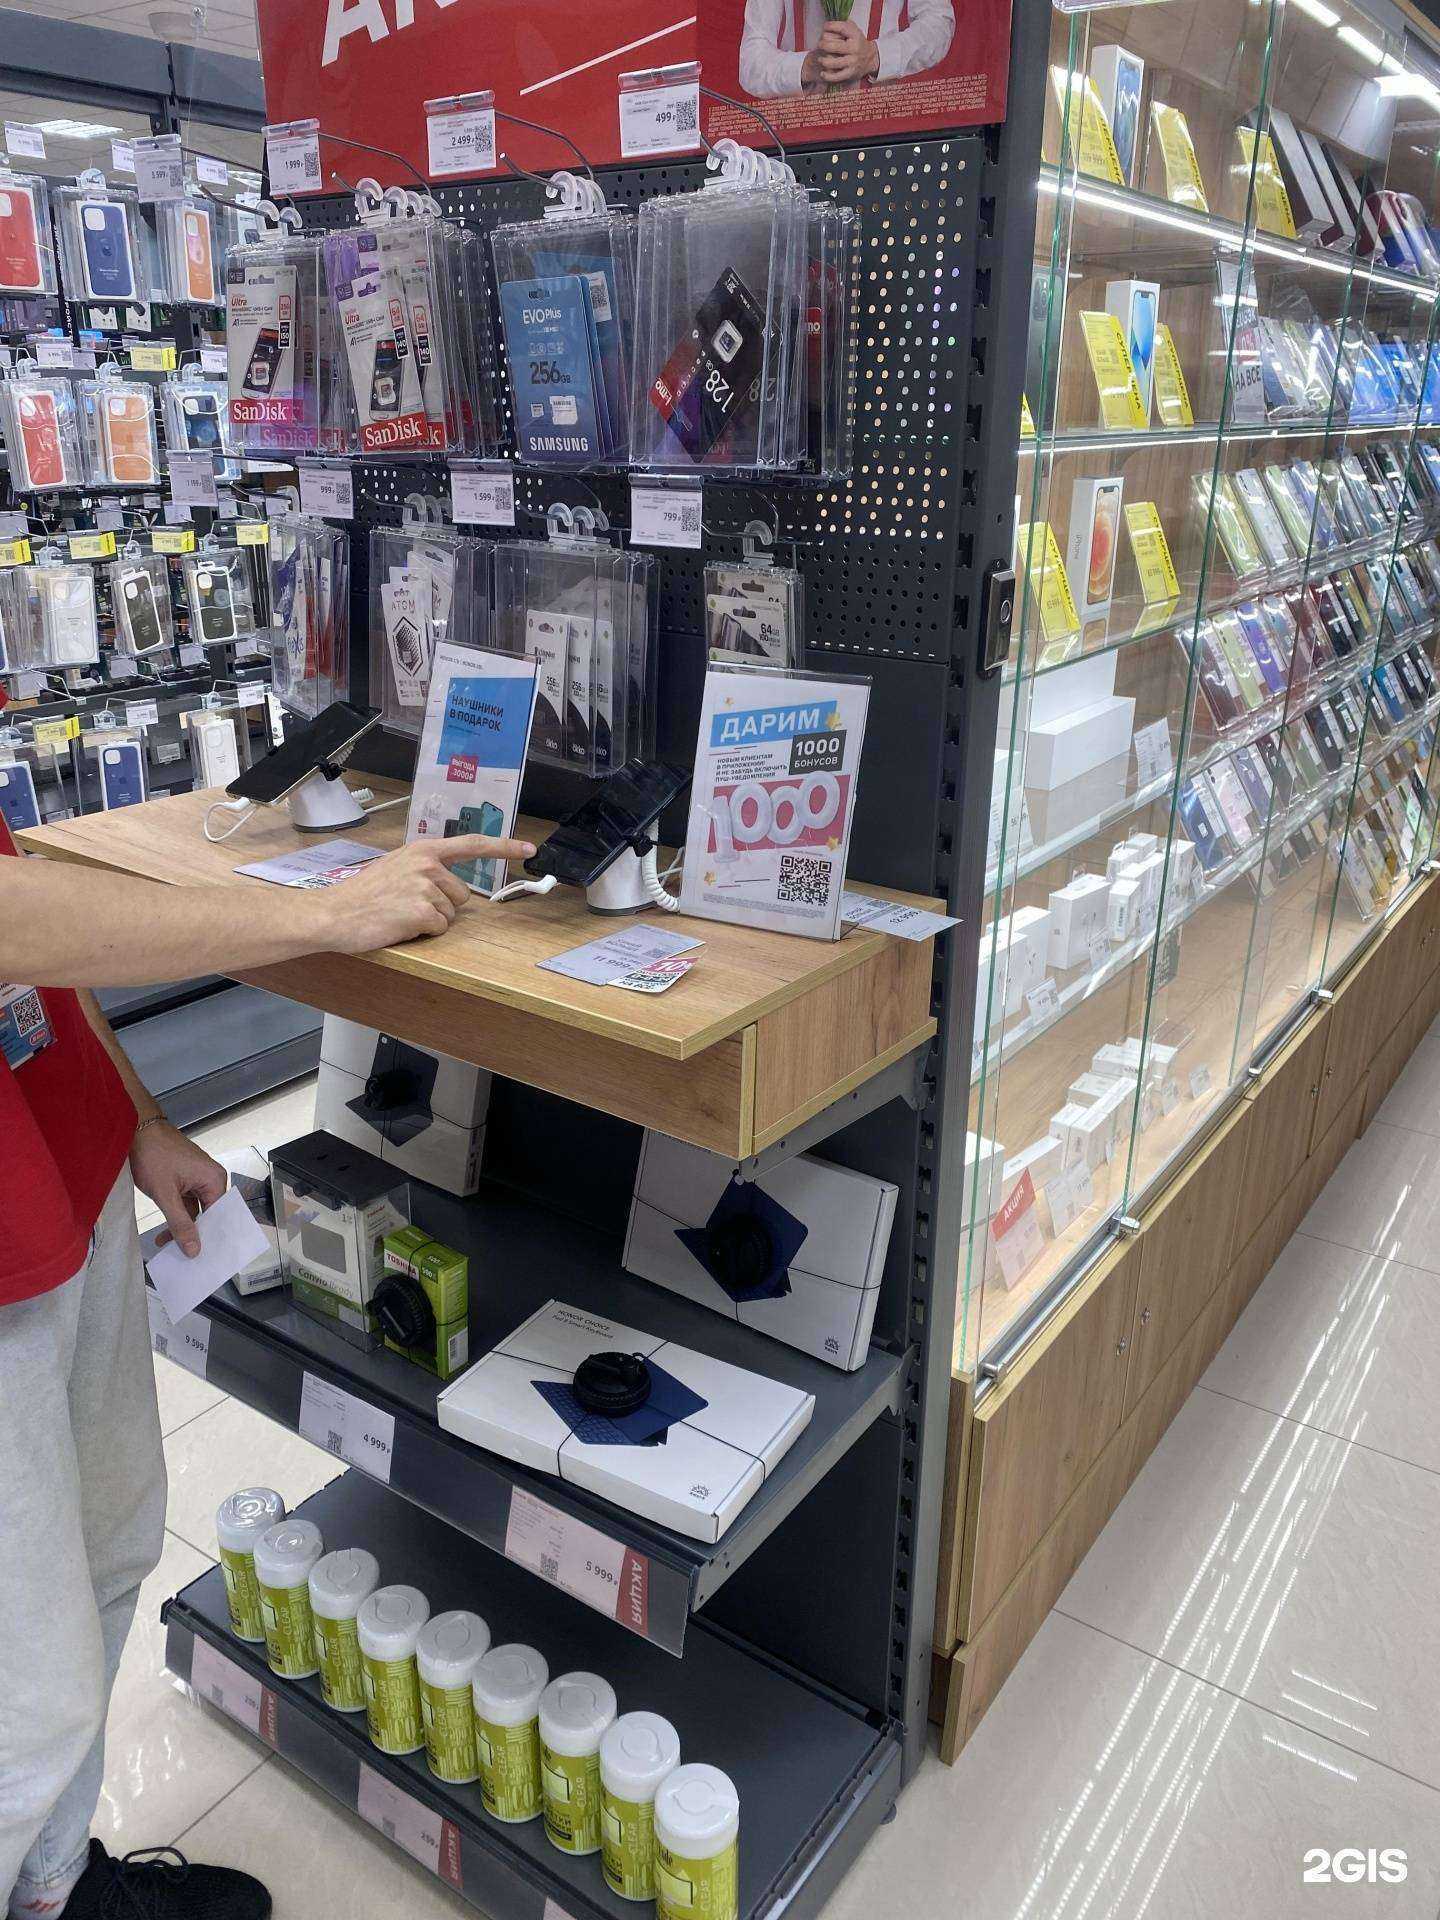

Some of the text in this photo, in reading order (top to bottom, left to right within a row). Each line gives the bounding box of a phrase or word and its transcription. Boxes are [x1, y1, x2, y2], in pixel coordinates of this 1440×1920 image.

[656, 112, 672, 123] 499
[231, 297, 247, 307] Ultra
[345, 311, 361, 325] Ultra
[522, 308, 562, 325] EVO Plus
[233, 402, 288, 421] SanDisk
[365, 417, 423, 447] SanDisk
[529, 437, 589, 452] SAMSUNG
[451, 694, 504, 718] НАУШНИКИ
[457, 710, 503, 732] ПОДАРОК
[720, 708, 821, 743] ДАРИМ
[795, 737, 841, 757] 1000
[717, 753, 774, 764] НОВЫМ КЛИЕНТАМ
[794, 756, 838, 769] БОНУСОВ
[715, 772, 777, 783] ПУШ-УВЕДОМЛЕНИЯ
[731, 767, 754, 775] ЗАБУДЬ
[754, 764, 788, 774] ВКЛЮЧИТЬ
[696, 771, 841, 863] 1000
[1003, 1185, 1025, 1223] АКЦИЯ
[386, 1253, 417, 1277] TOSHIBA
[298, 1267, 328, 1287] Canvio
[584, 1319, 610, 1332] CHOICE
[370, 1436, 386, 1451] 999
[594, 1565, 613, 1582] 999
[239, 1570, 249, 1601] CLEAR
[630, 1558, 643, 1626] АКЦИЯ
[280, 1606, 293, 1636] CLEAR
[329, 1637, 341, 1667] CLEAR
[576, 1776, 587, 1808] CLEAR
[627, 1821, 639, 1856] CLEAR
[699, 1879, 711, 1912] CLEAR
